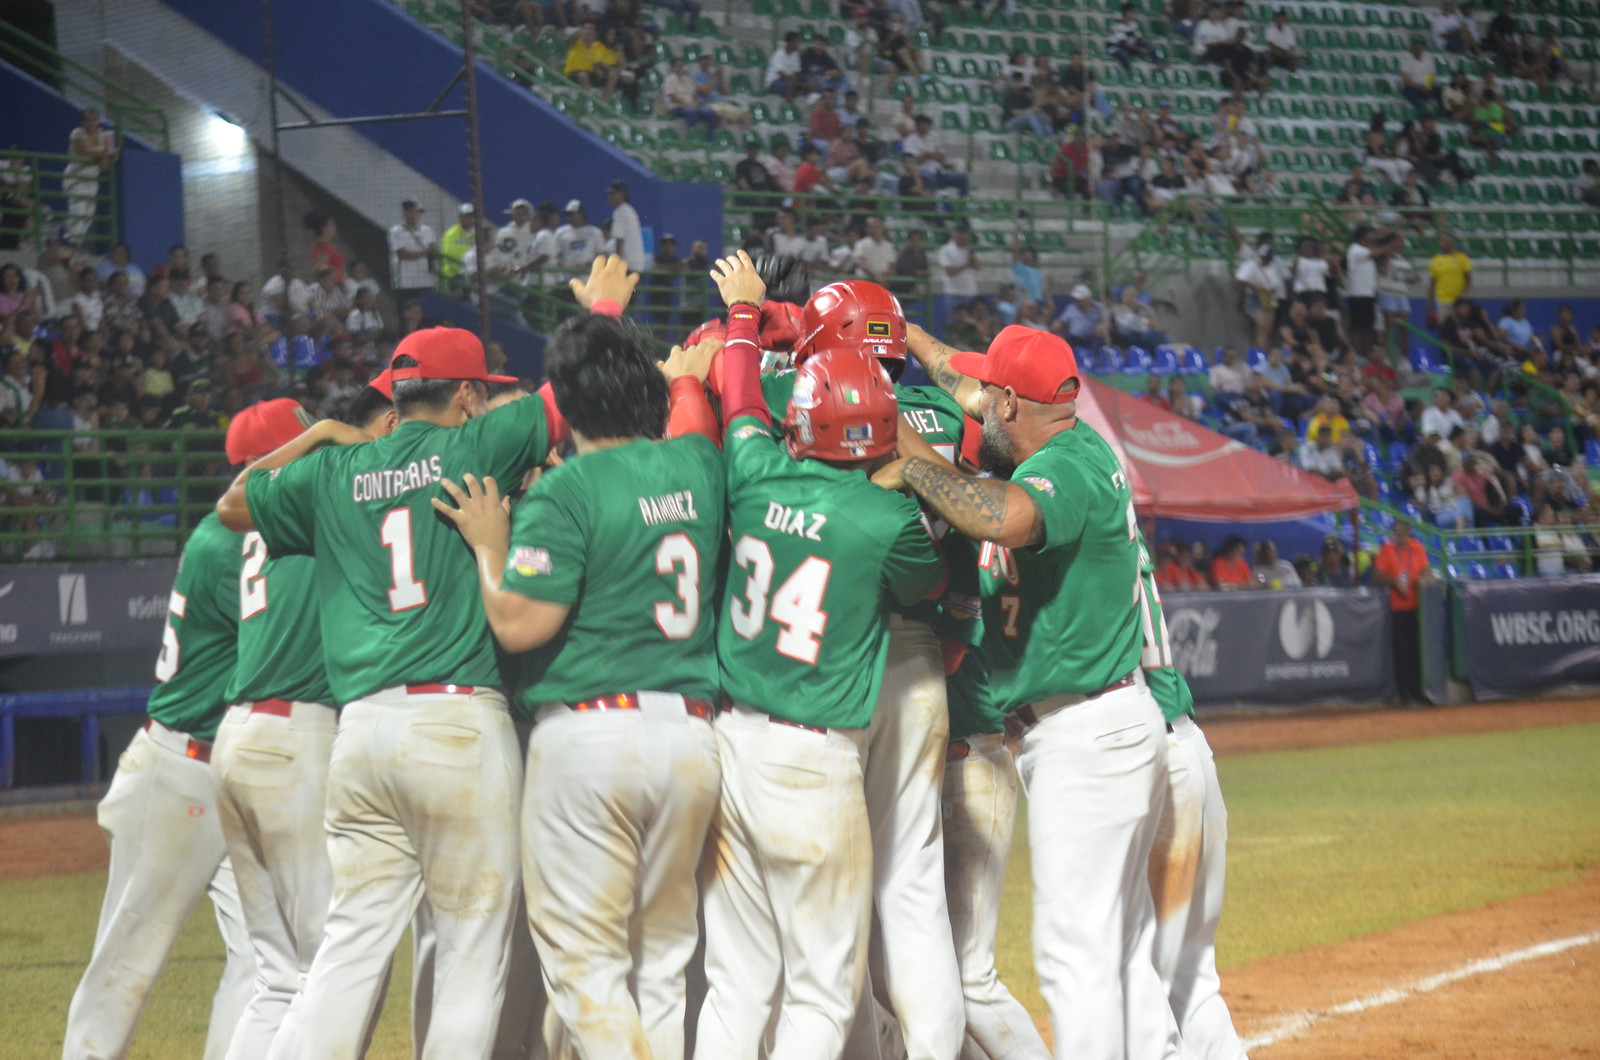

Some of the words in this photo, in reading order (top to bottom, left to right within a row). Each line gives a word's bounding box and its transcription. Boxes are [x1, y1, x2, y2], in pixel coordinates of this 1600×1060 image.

[638, 489, 698, 527] RAMIREZ
[764, 500, 827, 542] DIAZ
[379, 507, 427, 613] 1
[653, 531, 700, 641] 3
[729, 534, 832, 666] 34
[1001, 595, 1021, 638] 7
[1490, 610, 1600, 646] WBSC.ORG
